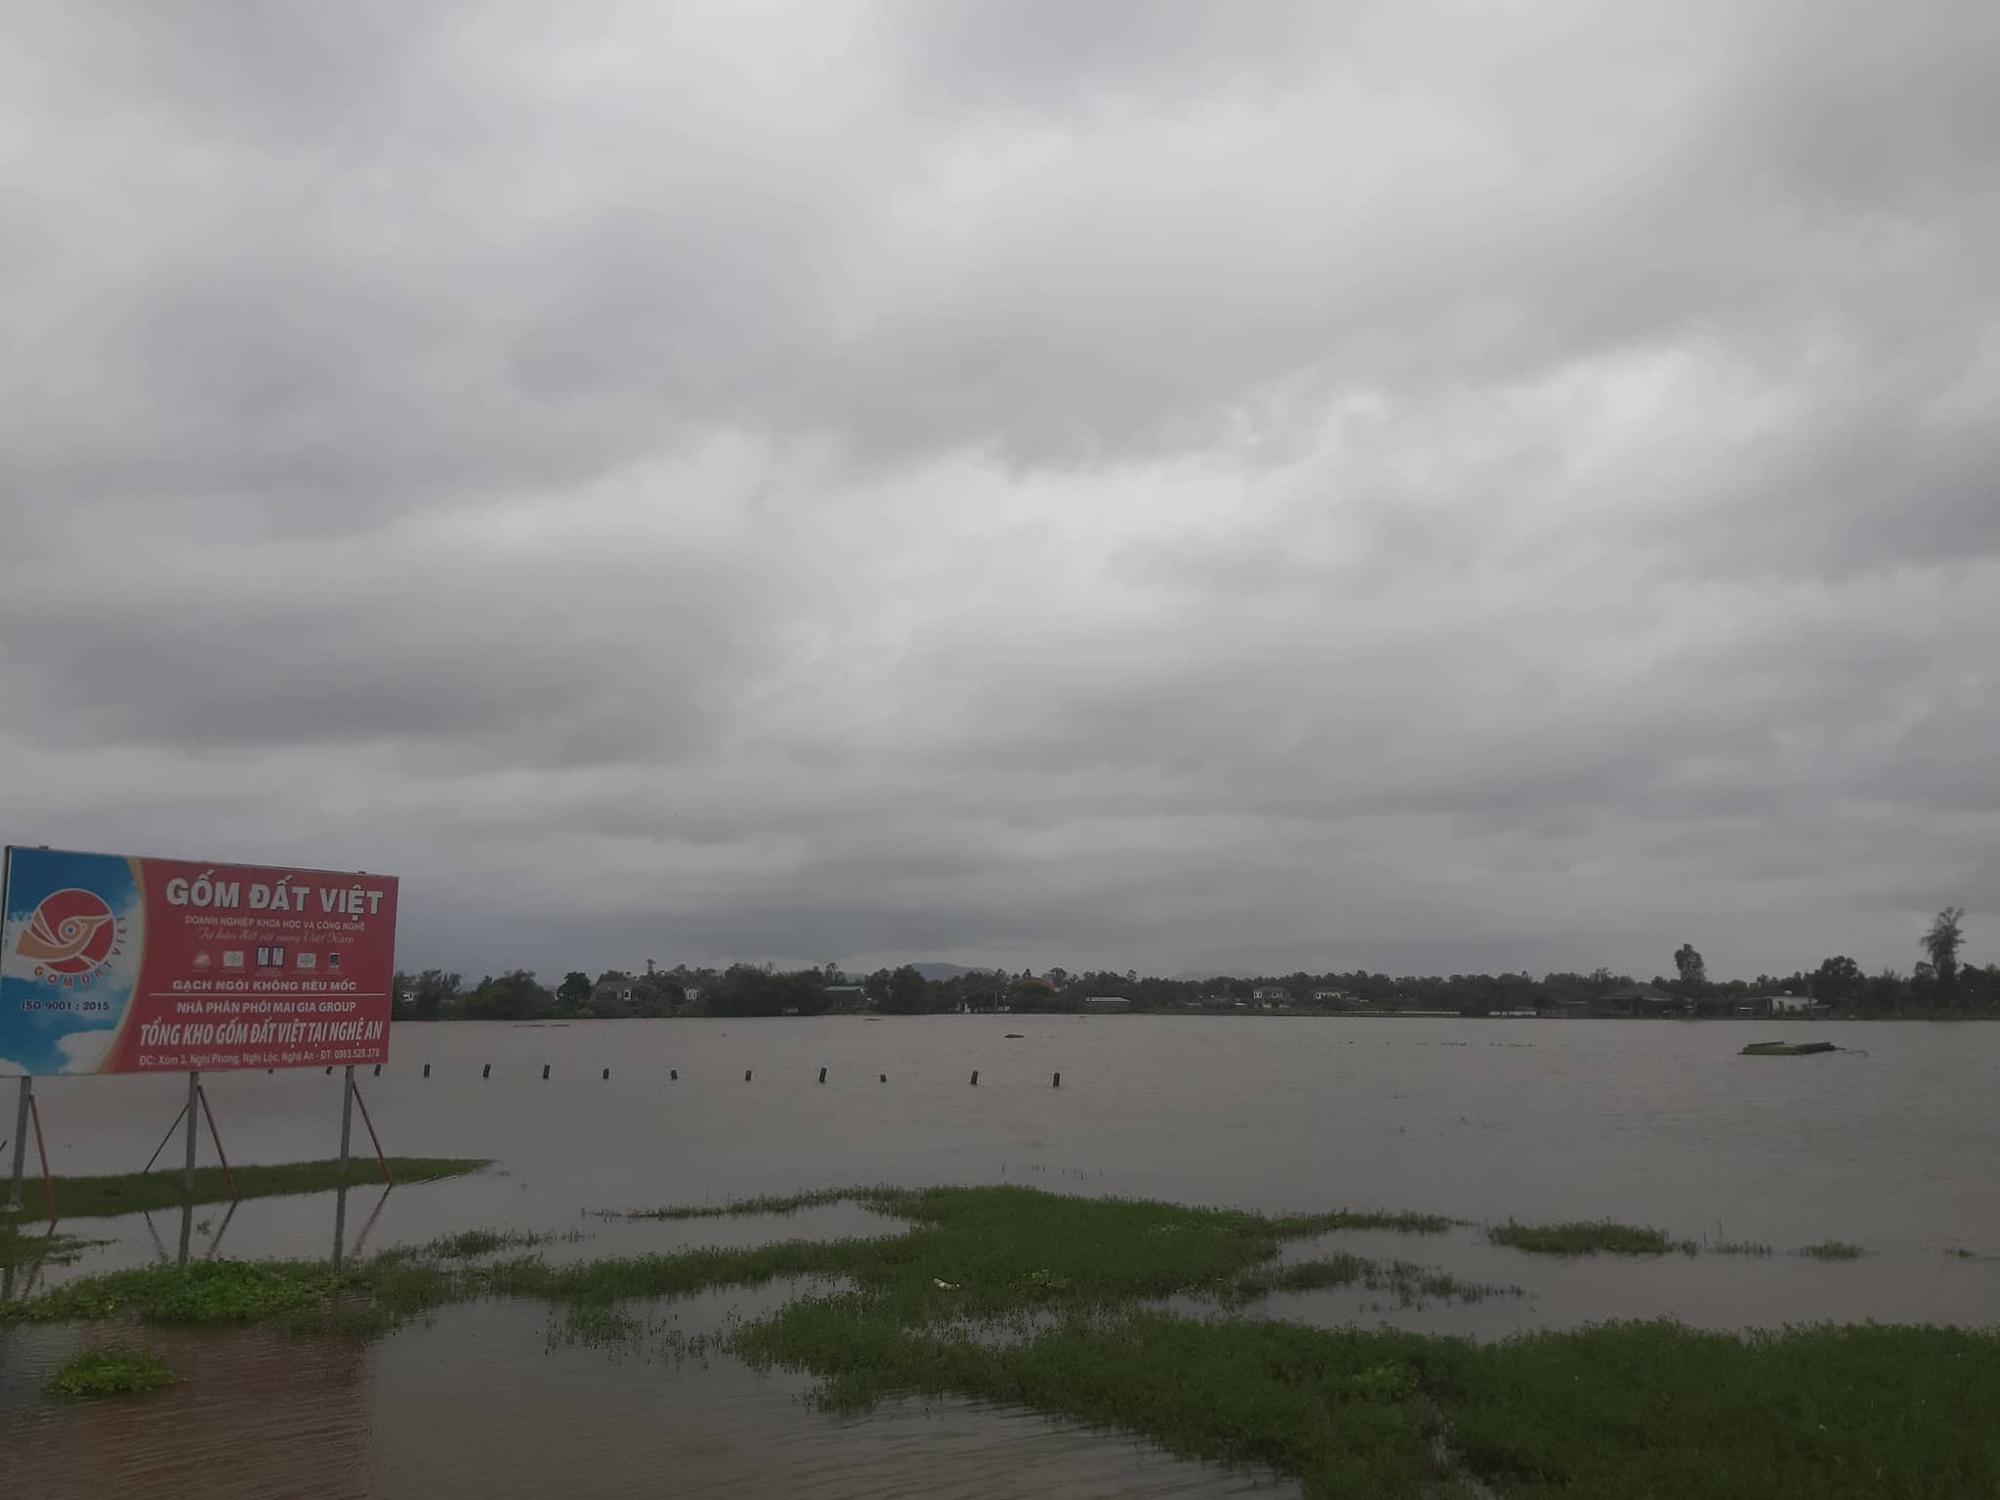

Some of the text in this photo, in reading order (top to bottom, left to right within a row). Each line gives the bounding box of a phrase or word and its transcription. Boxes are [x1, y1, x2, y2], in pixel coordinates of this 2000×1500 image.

[166, 870, 384, 921] GỐM ĐẤT VIỆT
[172, 980, 212, 992] GẠCH
[253, 979, 298, 991] KHÔNG
[302, 979, 328, 991] RÊU
[21, 1001, 41, 1010] ISO
[45, 1001, 71, 1010] 9001
[83, 1001, 109, 1011] 2015
[177, 1000, 203, 1013] NHÀ
[273, 1001, 295, 1013] MAI
[297, 1001, 317, 1013] GIA
[319, 1001, 357, 1013] GROUP
[140, 1015, 383, 1049] TỔNG KHO GỐM ĐẤT VIỆT TẠI NGHỆ AN
